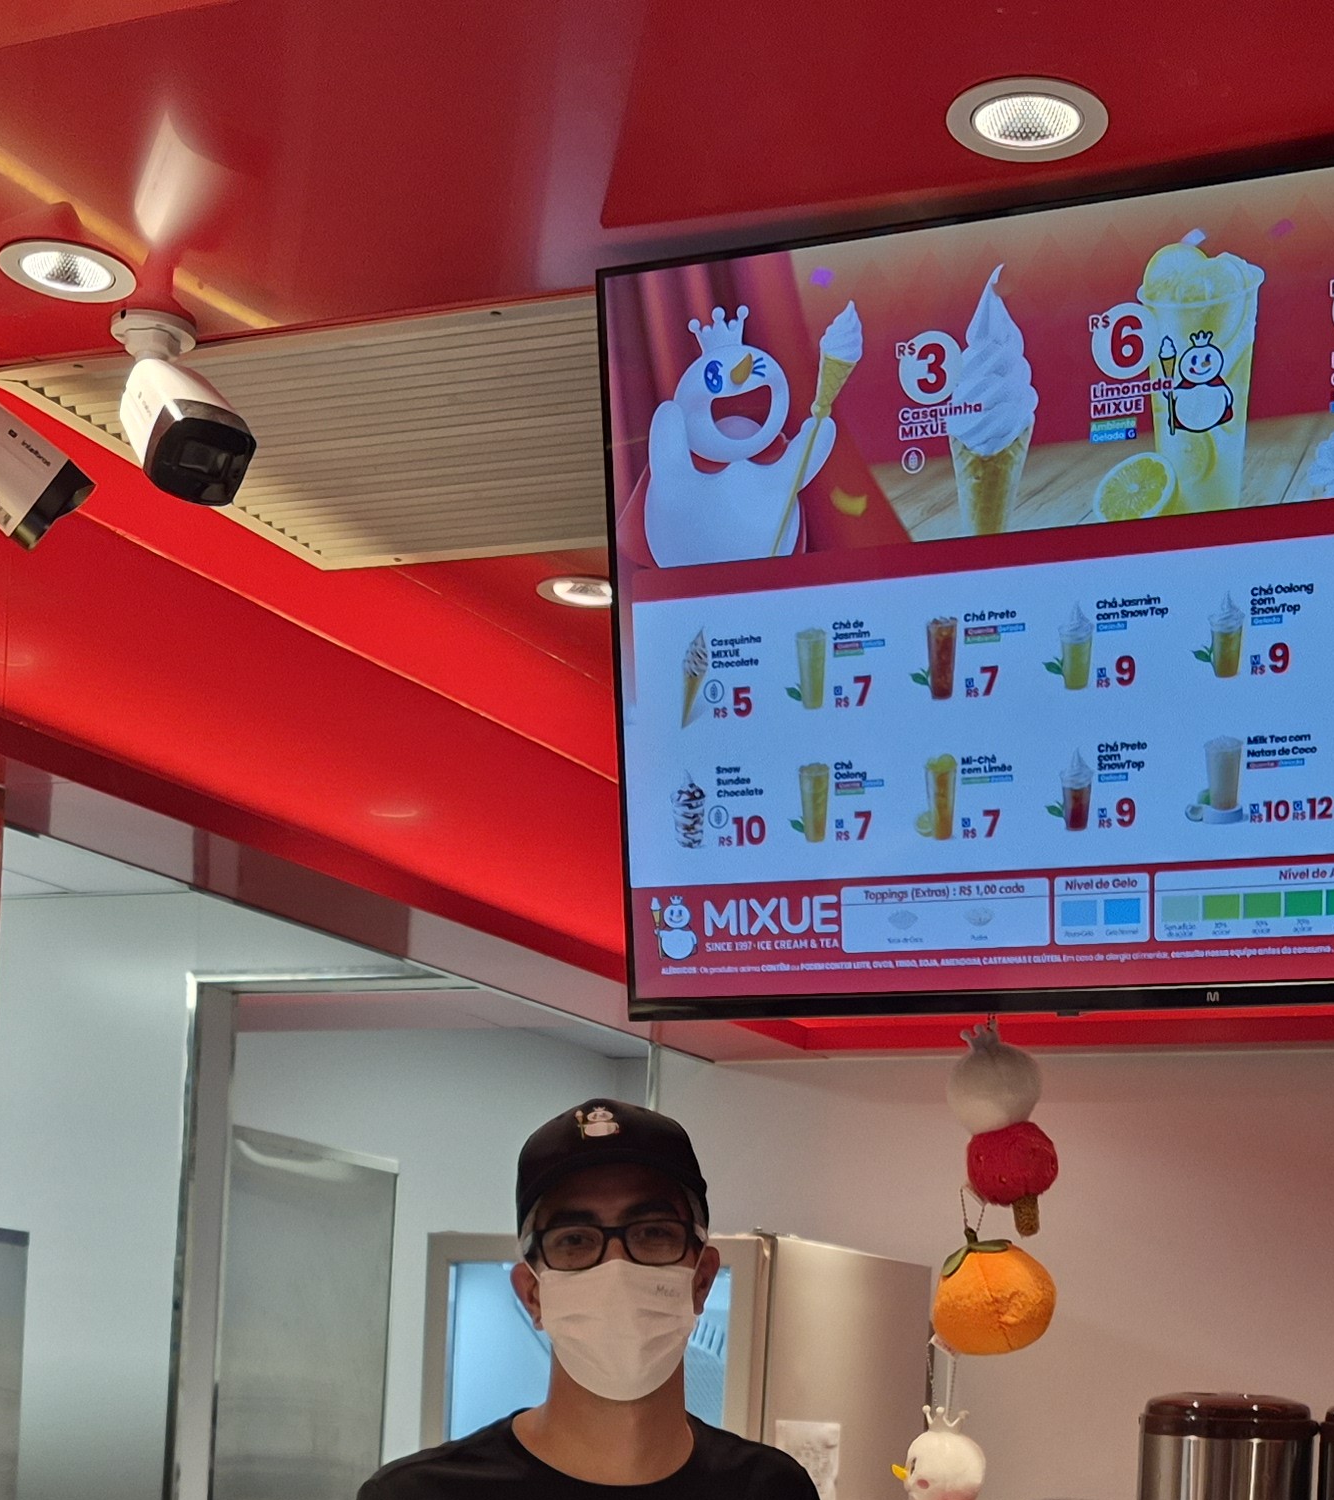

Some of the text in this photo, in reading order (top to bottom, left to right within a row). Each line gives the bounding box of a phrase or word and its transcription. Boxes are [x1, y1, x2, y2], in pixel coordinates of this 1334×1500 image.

[1111, 314, 1143, 368] 6
[917, 343, 947, 393] 3
[1091, 378, 1174, 400] Limonada
[900, 401, 983, 423] Casquinha
[1091, 399, 1144, 418] MIXUE
[899, 421, 949, 441] MIXUE
[703, 894, 839, 937] MIXUE
